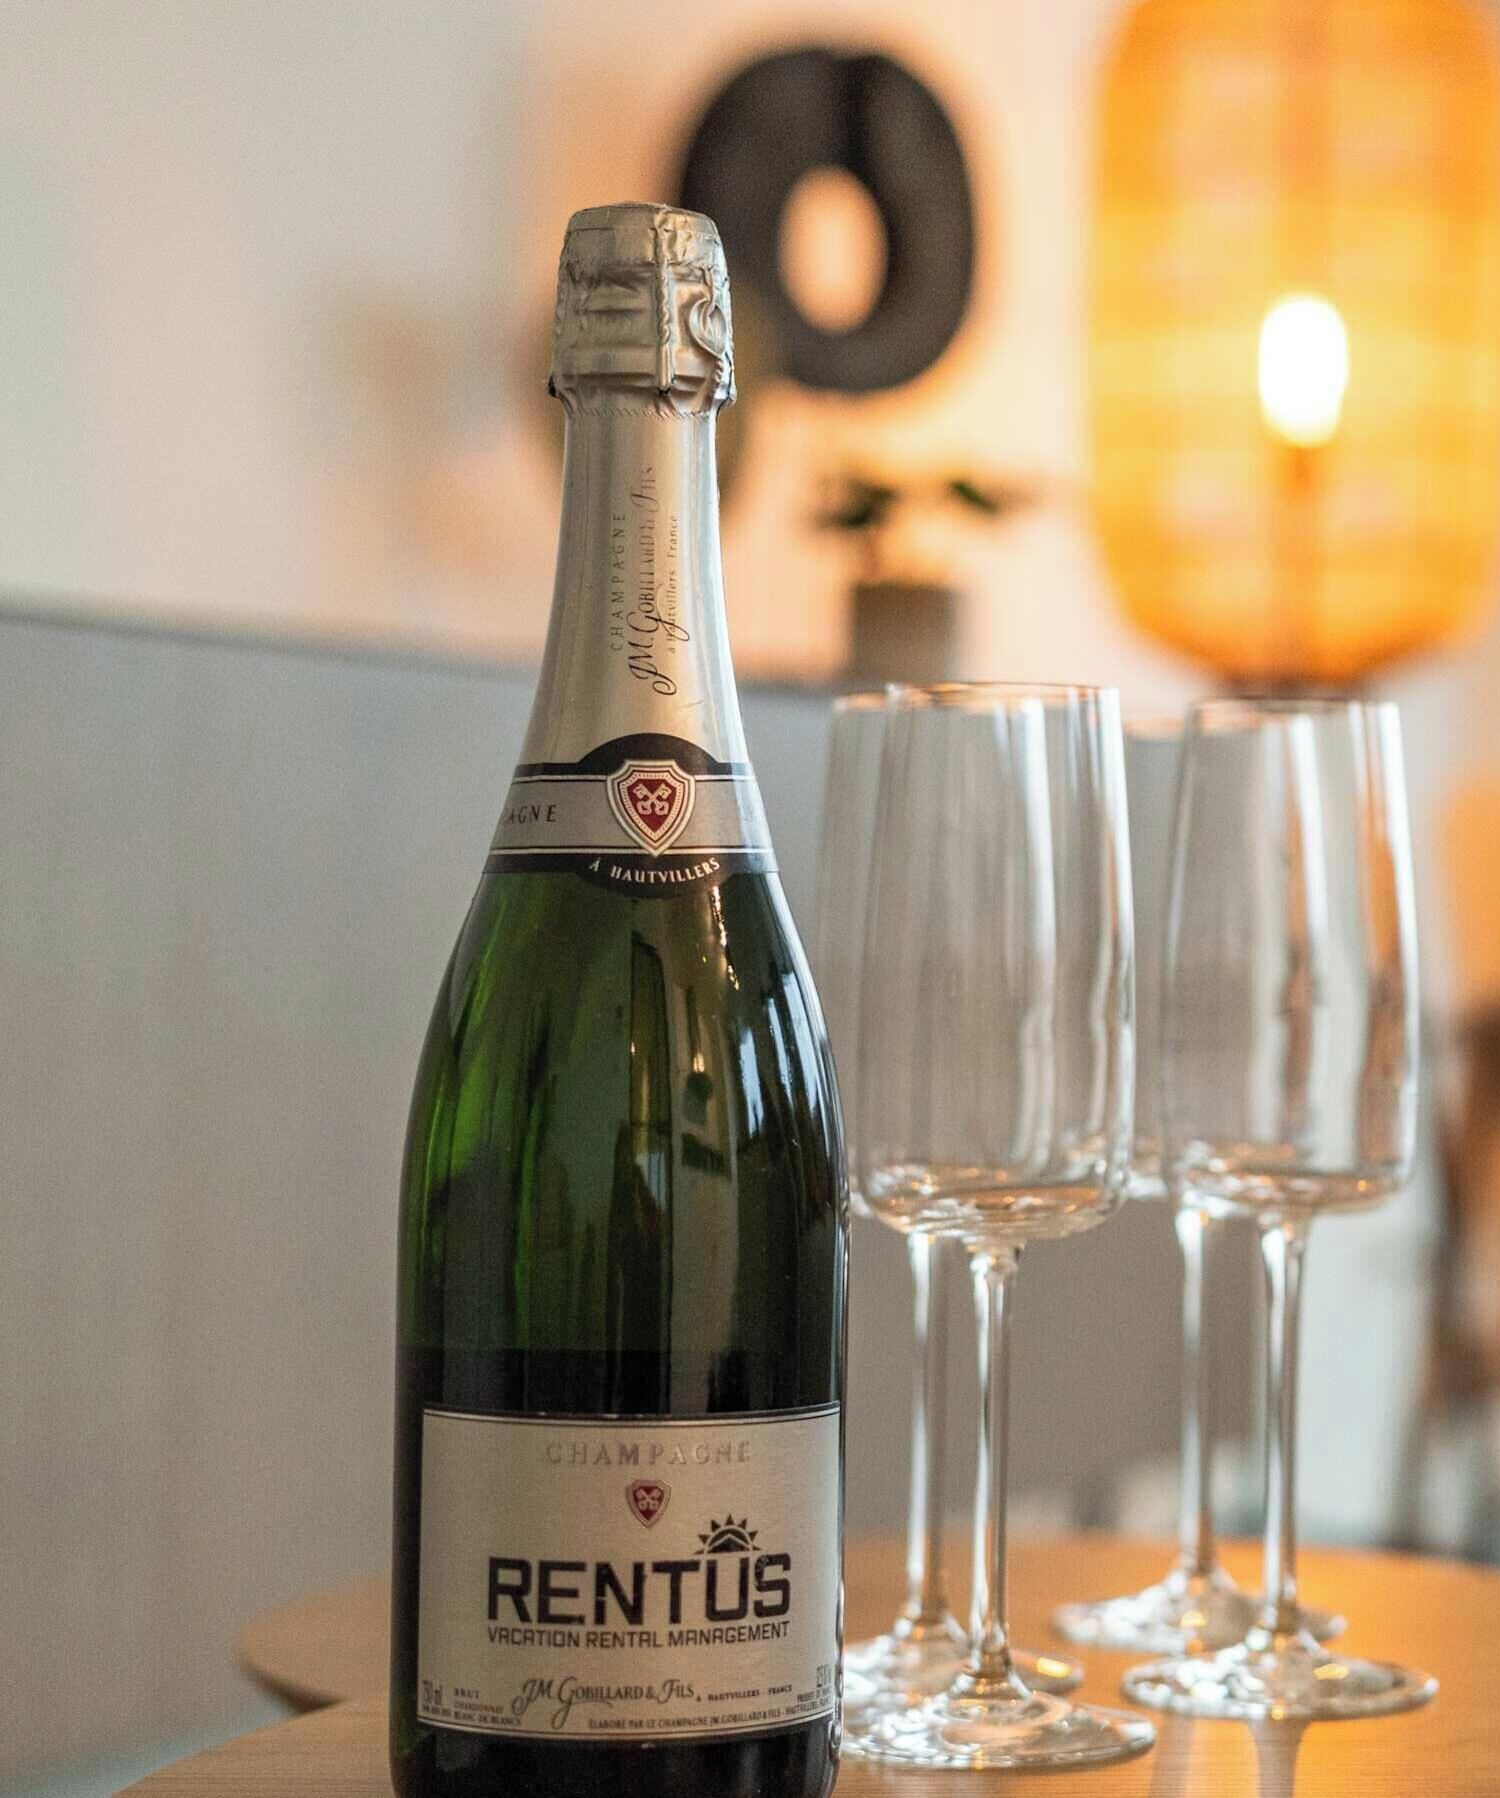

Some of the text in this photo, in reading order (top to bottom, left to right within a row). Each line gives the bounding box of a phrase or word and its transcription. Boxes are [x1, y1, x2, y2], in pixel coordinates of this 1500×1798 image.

[667, 515, 678, 558] France
[610, 513, 625, 652] CHAMPAGNE
[503, 803, 557, 825] AGNE
[610, 856, 721, 884] HAUTVILLERS
[546, 1439, 751, 1467] CHAMPAGNE
[487, 1552, 791, 1626] RENTUS
[487, 1620, 790, 1649] VACATION RENTAL MANAGEMENT
[454, 1687, 480, 1700] BRUT
[767, 1684, 792, 1696] FRANCE
